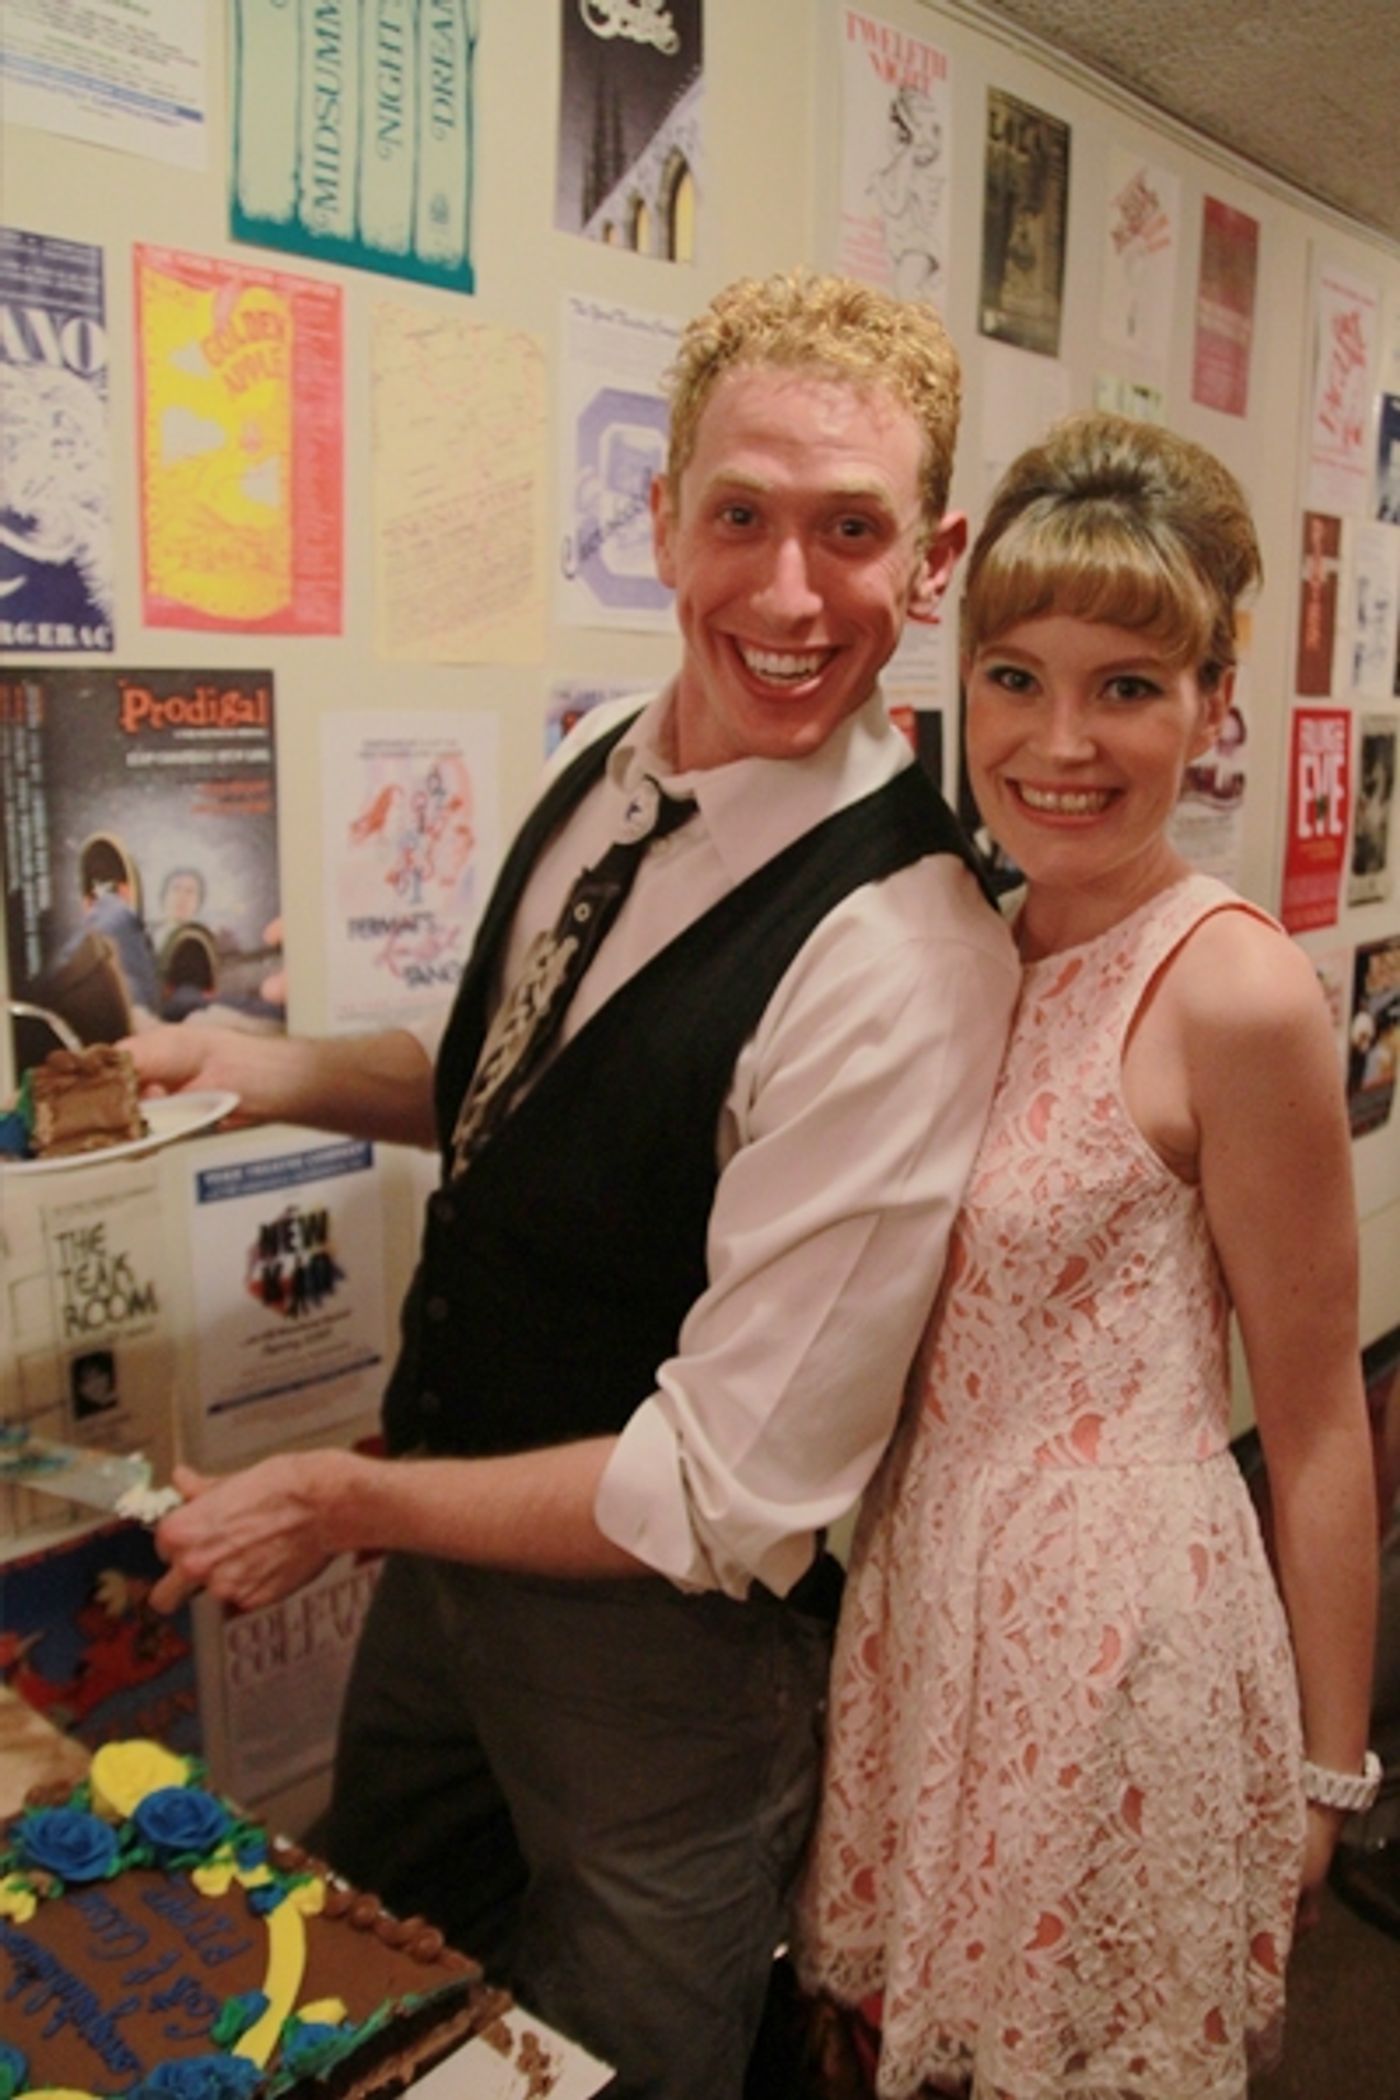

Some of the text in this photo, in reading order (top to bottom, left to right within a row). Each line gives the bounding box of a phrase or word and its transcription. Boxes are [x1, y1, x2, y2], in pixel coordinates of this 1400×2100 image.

[118, 680, 269, 734] Prodigal
[54, 1221, 106, 1263] THE
[62, 1279, 159, 1338] ROOM
